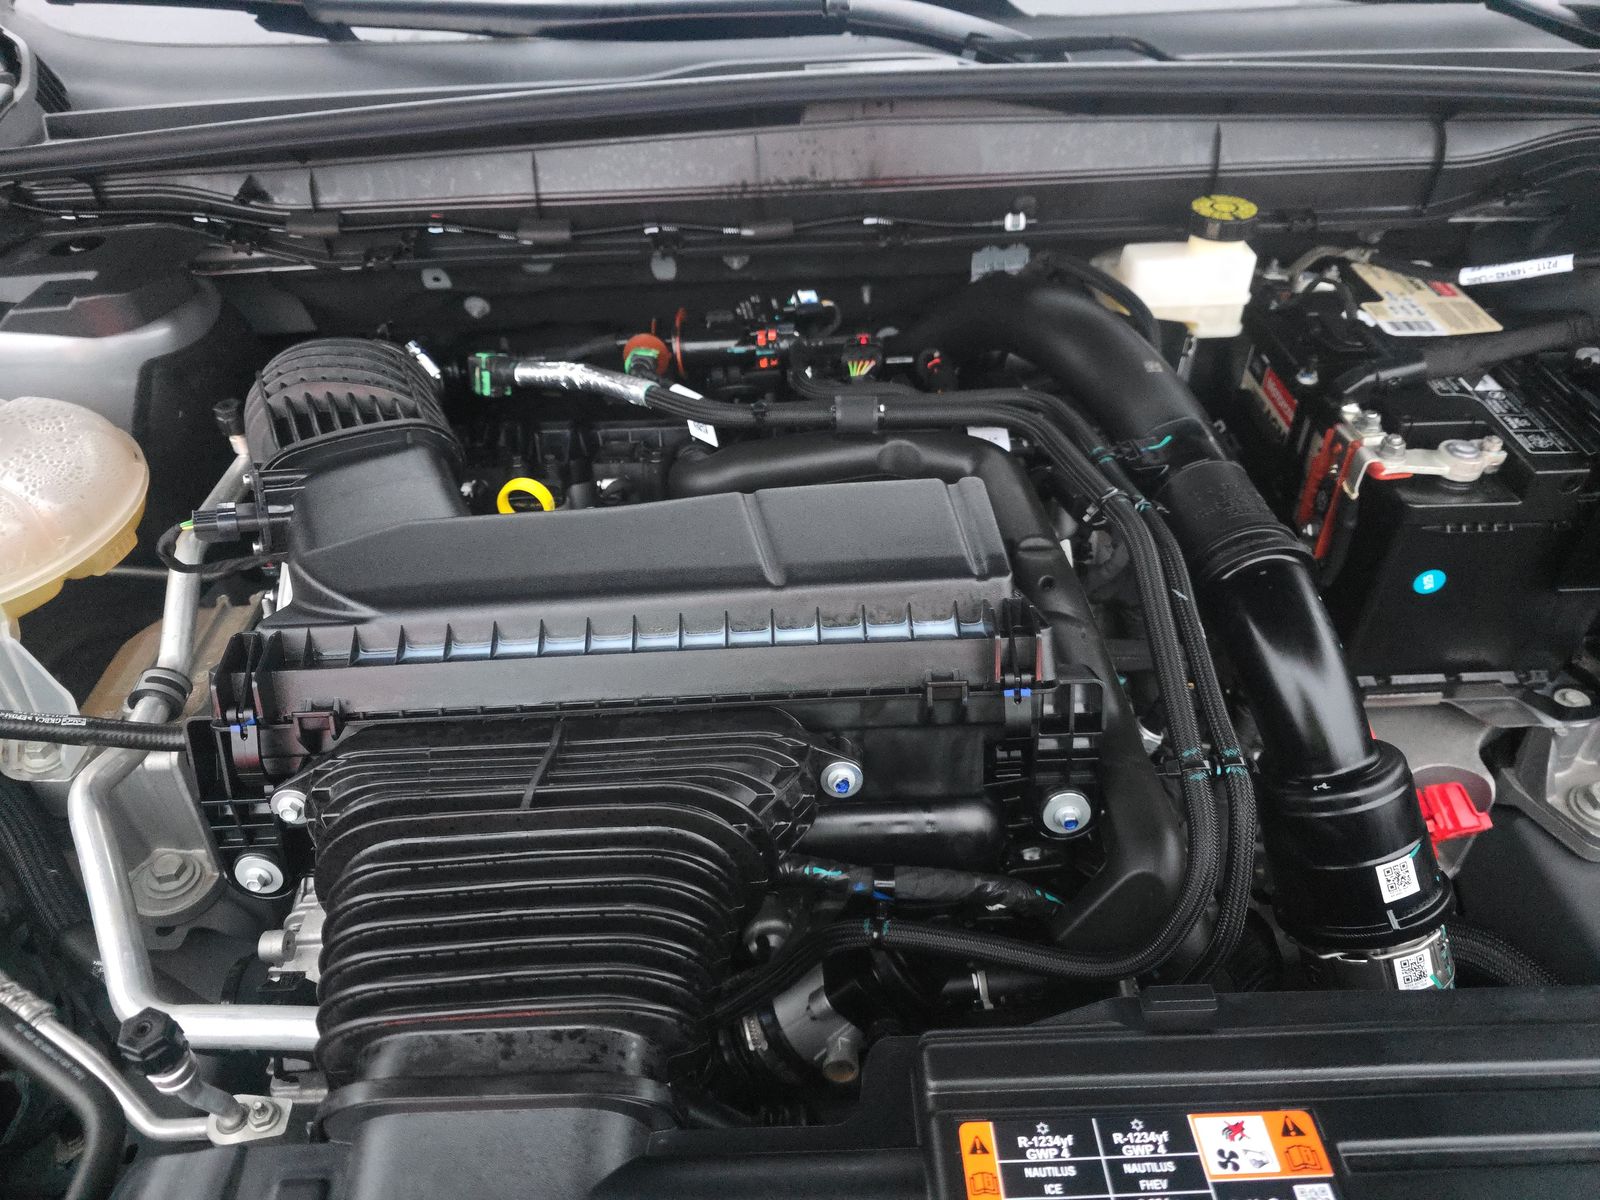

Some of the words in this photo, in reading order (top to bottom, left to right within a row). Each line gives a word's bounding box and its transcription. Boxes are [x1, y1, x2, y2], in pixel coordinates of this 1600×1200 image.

[1017, 1134, 1074, 1149] R-1234yf
[1112, 1130, 1169, 1145] R-1234yf
[1025, 1148, 1058, 1160] GWP
[1060, 1147, 1071, 1158] 4
[1121, 1144, 1155, 1156] GWP
[1157, 1144, 1168, 1155] 4
[1023, 1165, 1077, 1178] NAUTILUS
[1122, 1161, 1176, 1174] NAUTILUS
[1043, 1183, 1064, 1195] ICE
[1138, 1179, 1168, 1191] FHEV
